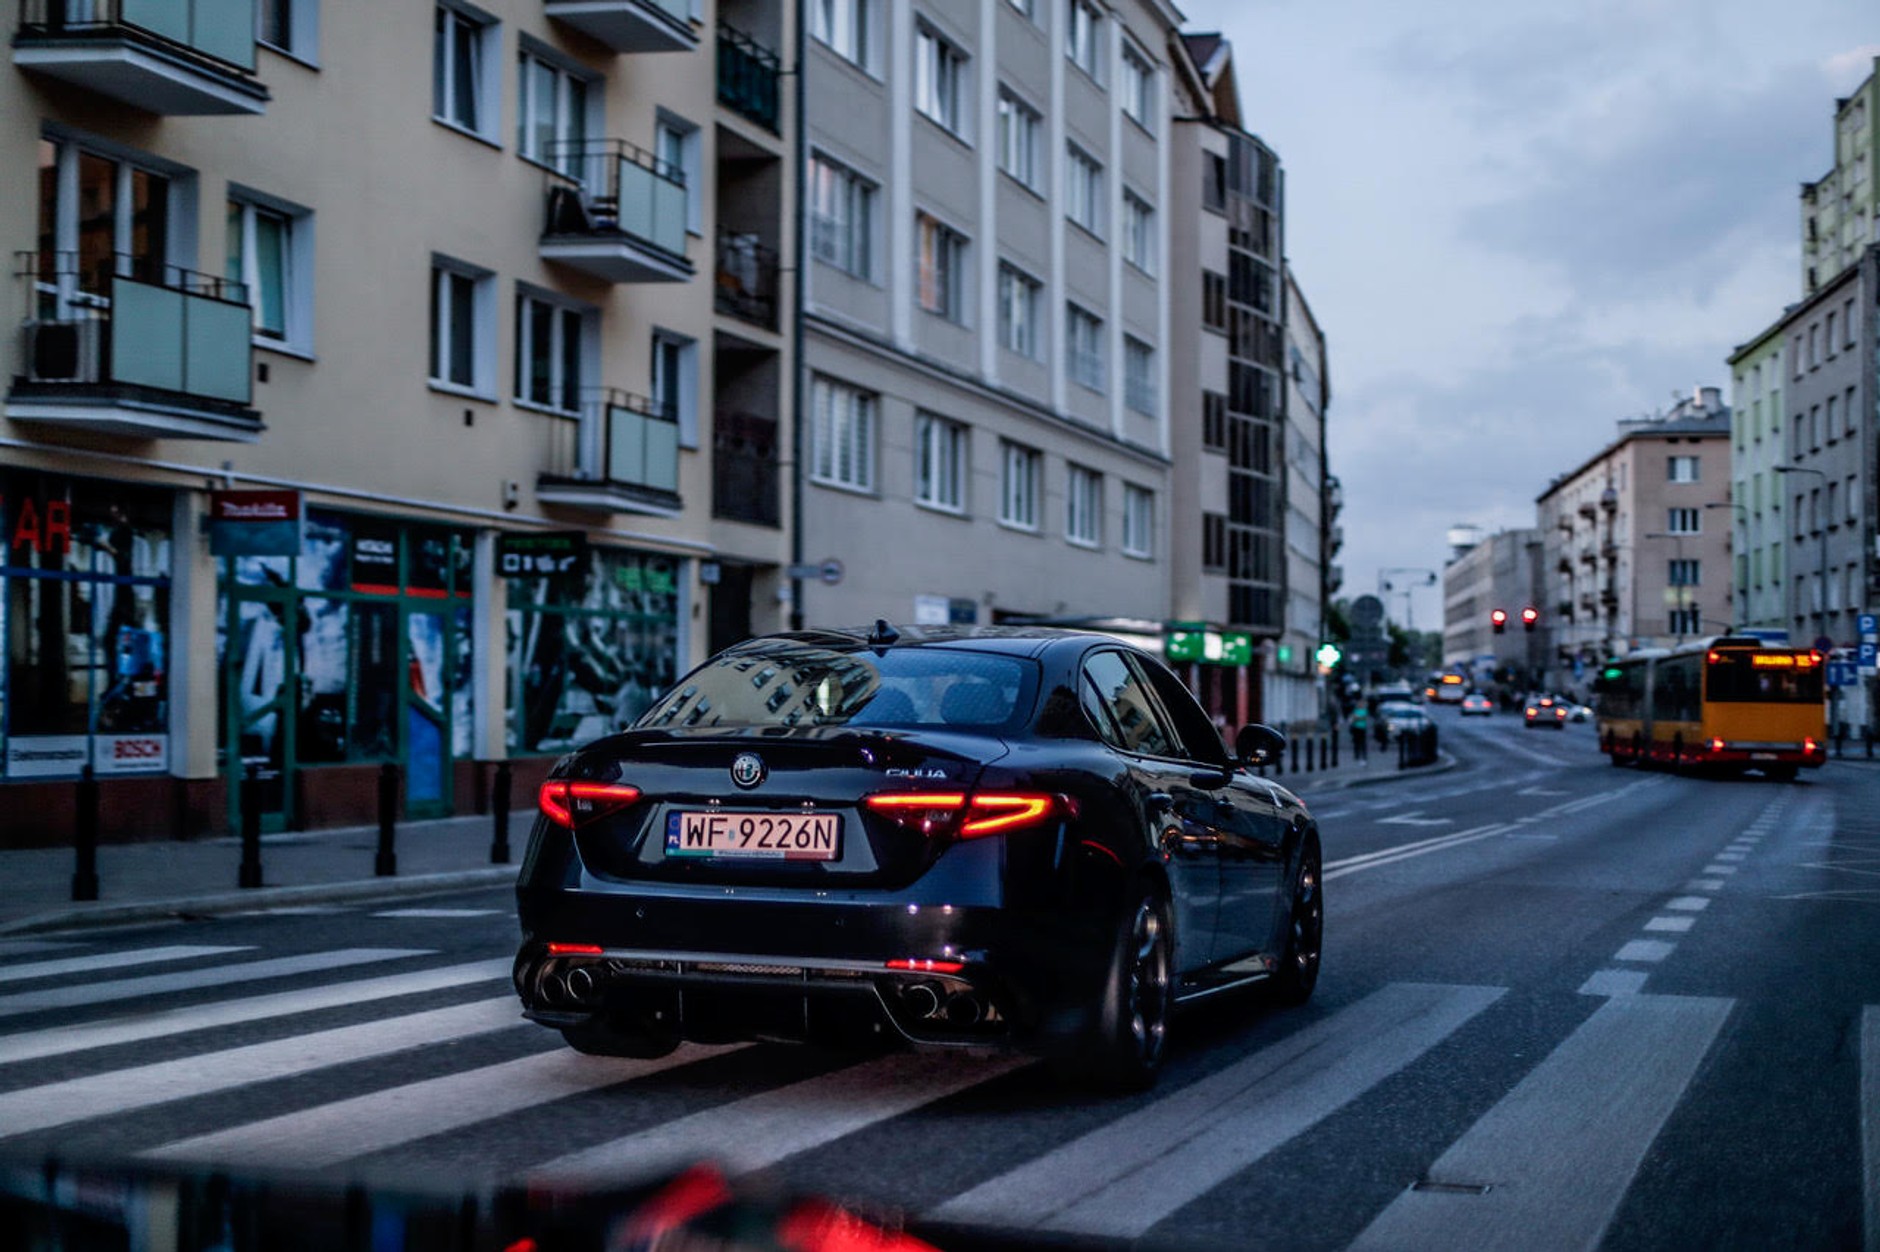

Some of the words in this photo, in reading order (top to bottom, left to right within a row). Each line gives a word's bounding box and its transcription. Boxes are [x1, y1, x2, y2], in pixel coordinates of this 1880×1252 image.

[0, 495, 71, 555] AR
[1860, 616, 1874, 631] P
[1860, 644, 1874, 659] P
[686, 816, 729, 847] WF
[739, 817, 833, 850] 9226N
